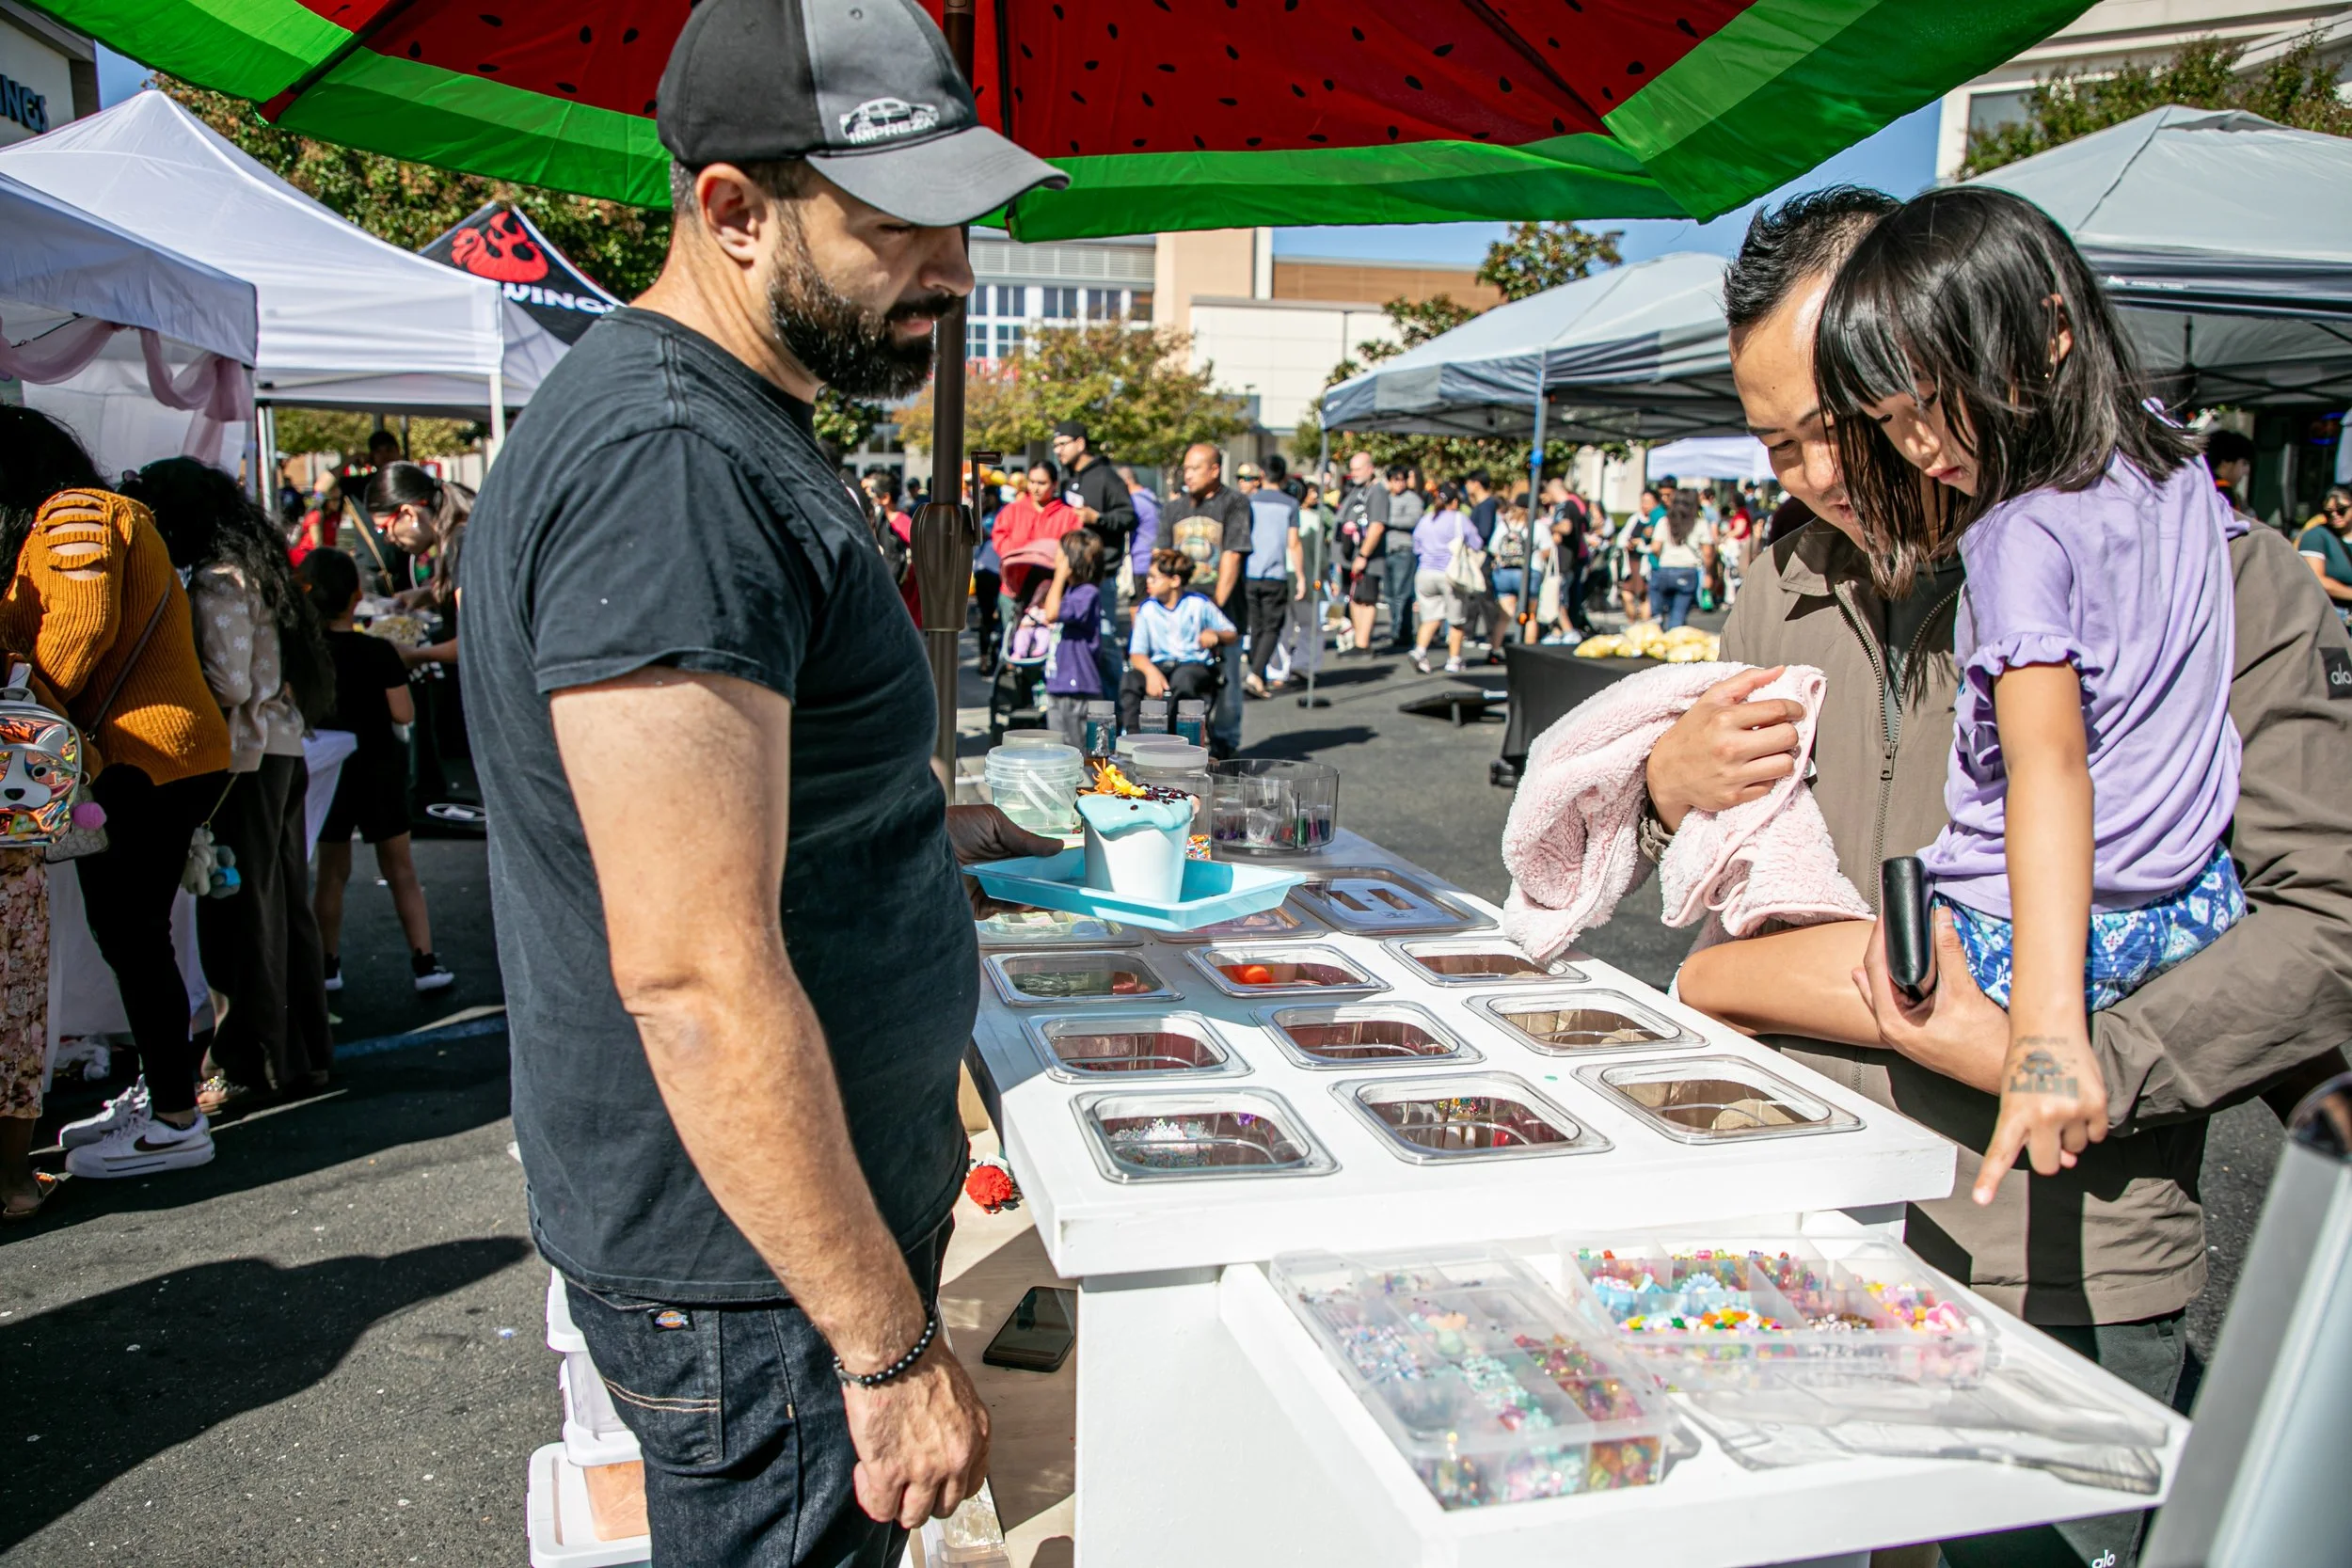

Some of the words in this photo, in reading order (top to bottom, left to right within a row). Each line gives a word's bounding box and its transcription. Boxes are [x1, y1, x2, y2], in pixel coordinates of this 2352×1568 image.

[849, 117, 936, 144] IMPREZA
[502, 281, 616, 315] WING
[2330, 662, 2352, 685] alo
[2091, 1548, 2116, 1568] alo
